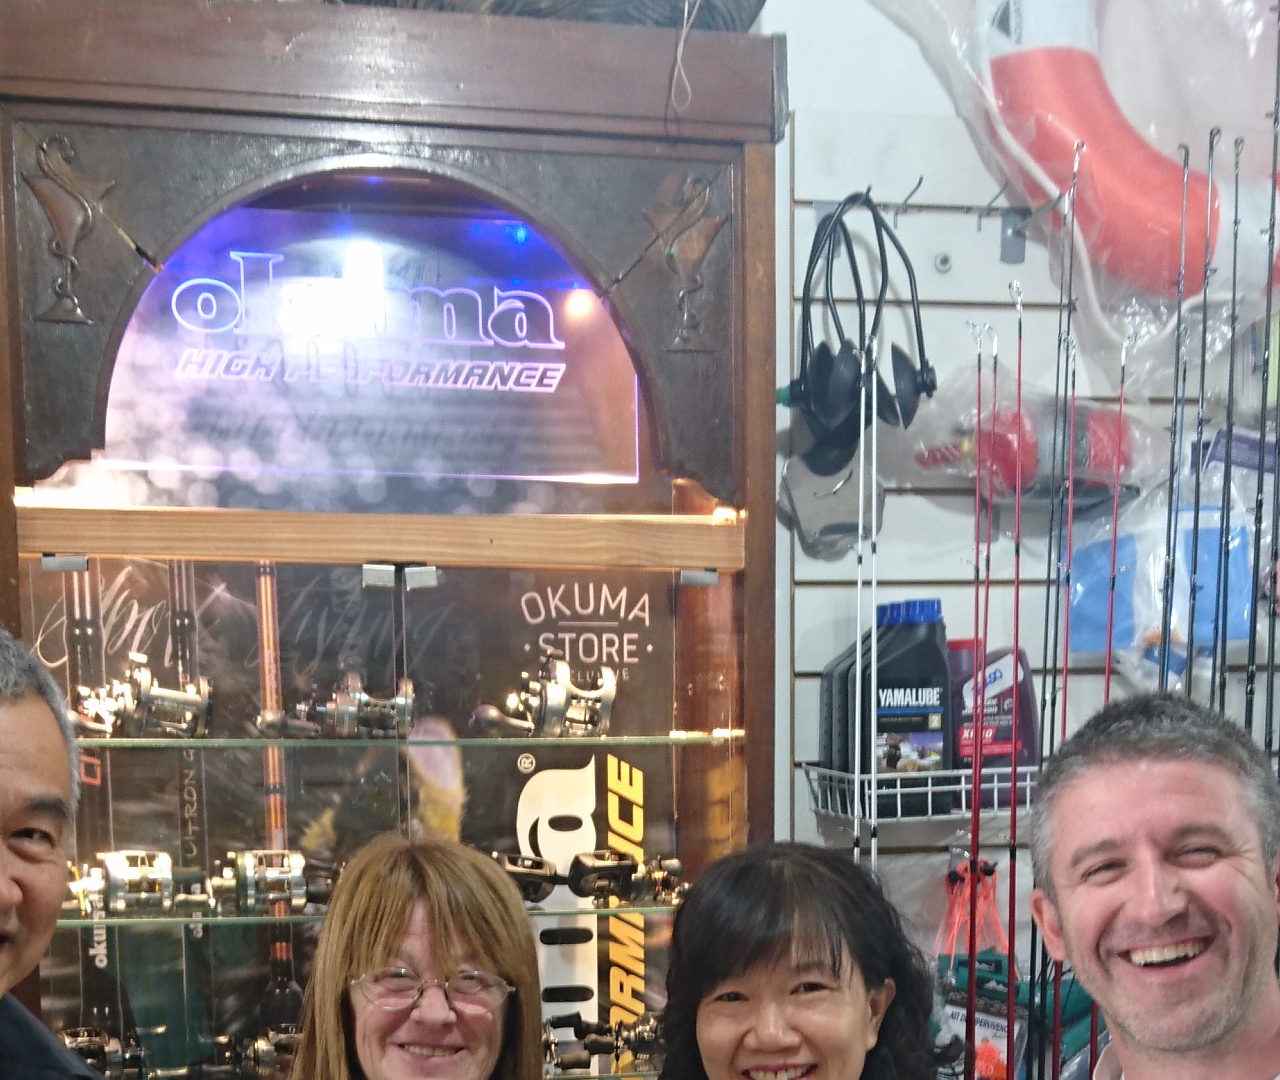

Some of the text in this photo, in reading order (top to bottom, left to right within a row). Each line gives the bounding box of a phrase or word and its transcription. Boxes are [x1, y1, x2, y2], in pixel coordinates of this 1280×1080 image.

[173, 347, 283, 381] HIGH
[520, 581, 650, 628] OKUMA
[538, 632, 640, 664] STORE
[878, 687, 941, 708] YAMALUBE
